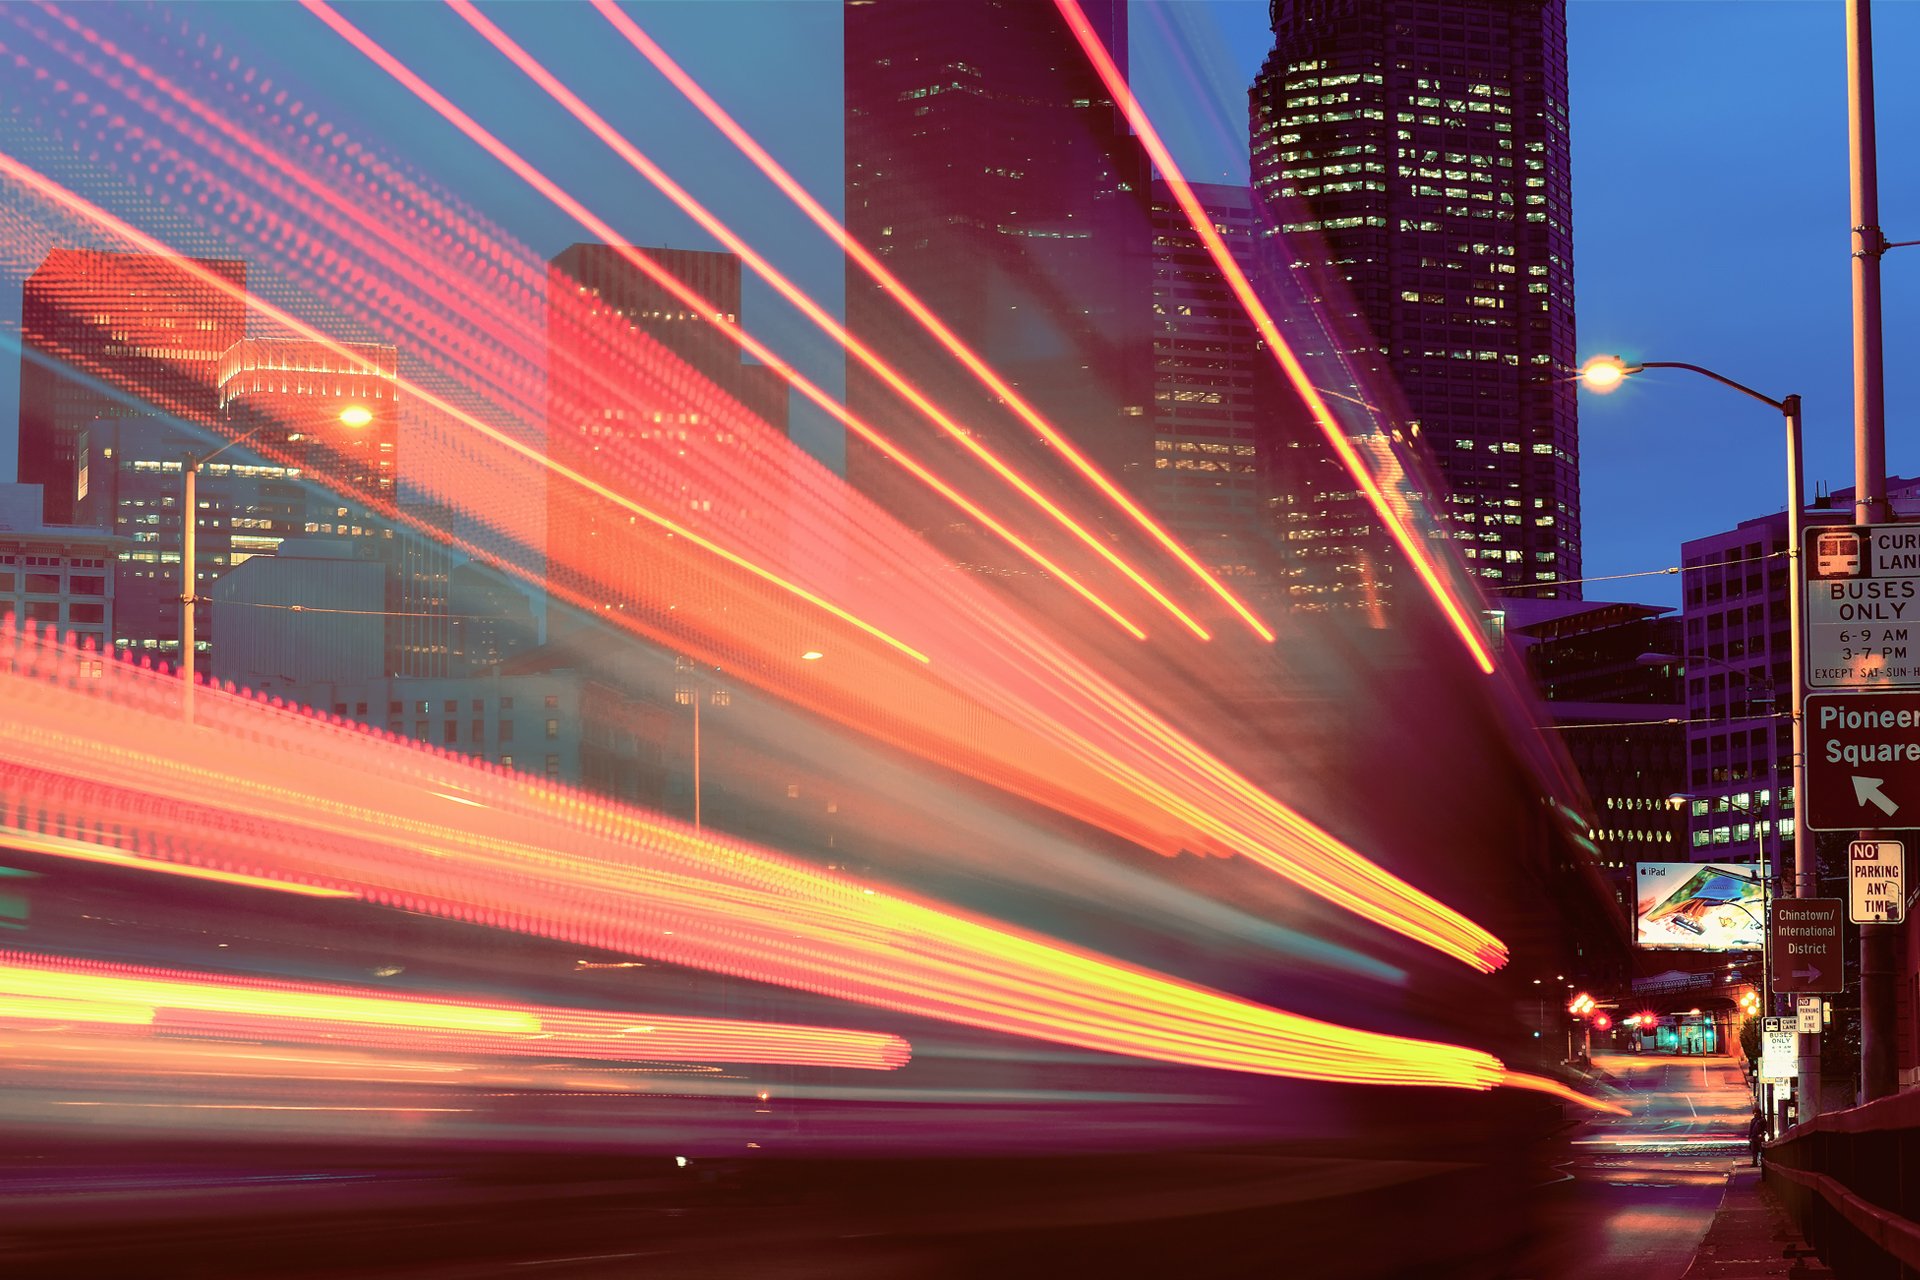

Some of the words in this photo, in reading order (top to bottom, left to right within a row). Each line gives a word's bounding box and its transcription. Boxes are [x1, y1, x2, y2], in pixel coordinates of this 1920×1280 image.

[1878, 534, 1920, 550] CUR
[1879, 554, 1920, 570] LAN
[1831, 581, 1915, 600] BUSES
[1839, 602, 1906, 621] ONLY
[1839, 630, 1871, 642] 6-9
[1883, 629, 1908, 641] AM
[1842, 647, 1872, 660] 3-7
[1882, 647, 1907, 659] PM
[1815, 668, 1854, 679] EXCEPT
[1825, 738, 1920, 768] Square
[1854, 844, 1875, 858] NO
[1648, 868, 1666, 876] iPad
[1855, 865, 1899, 878] PARKING
[1867, 883, 1888, 895] ANY
[1779, 909, 1835, 921] Chinatown/
[1778, 925, 1836, 937] International
[1788, 943, 1827, 954] District
